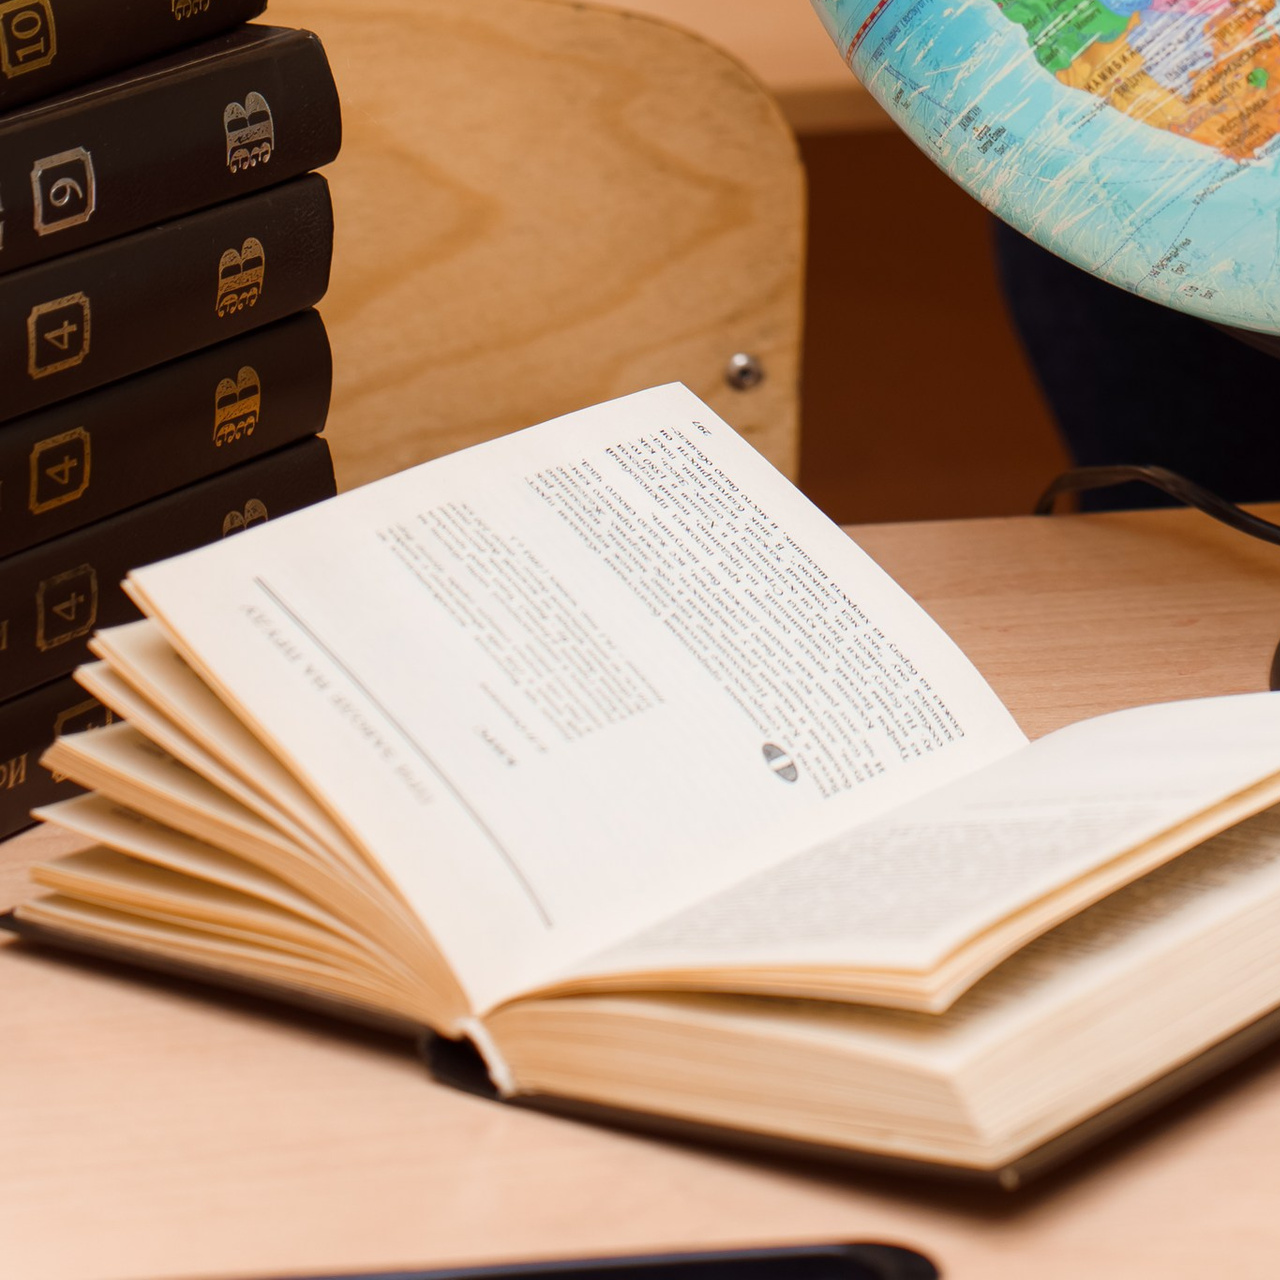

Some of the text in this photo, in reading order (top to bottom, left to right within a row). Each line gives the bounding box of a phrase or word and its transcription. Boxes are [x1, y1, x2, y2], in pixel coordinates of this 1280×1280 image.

[12, 10, 46, 62] 10
[49, 177, 83, 208] 9
[44, 321, 77, 349] 4
[44, 456, 77, 484] 4
[52, 593, 84, 621] 4
